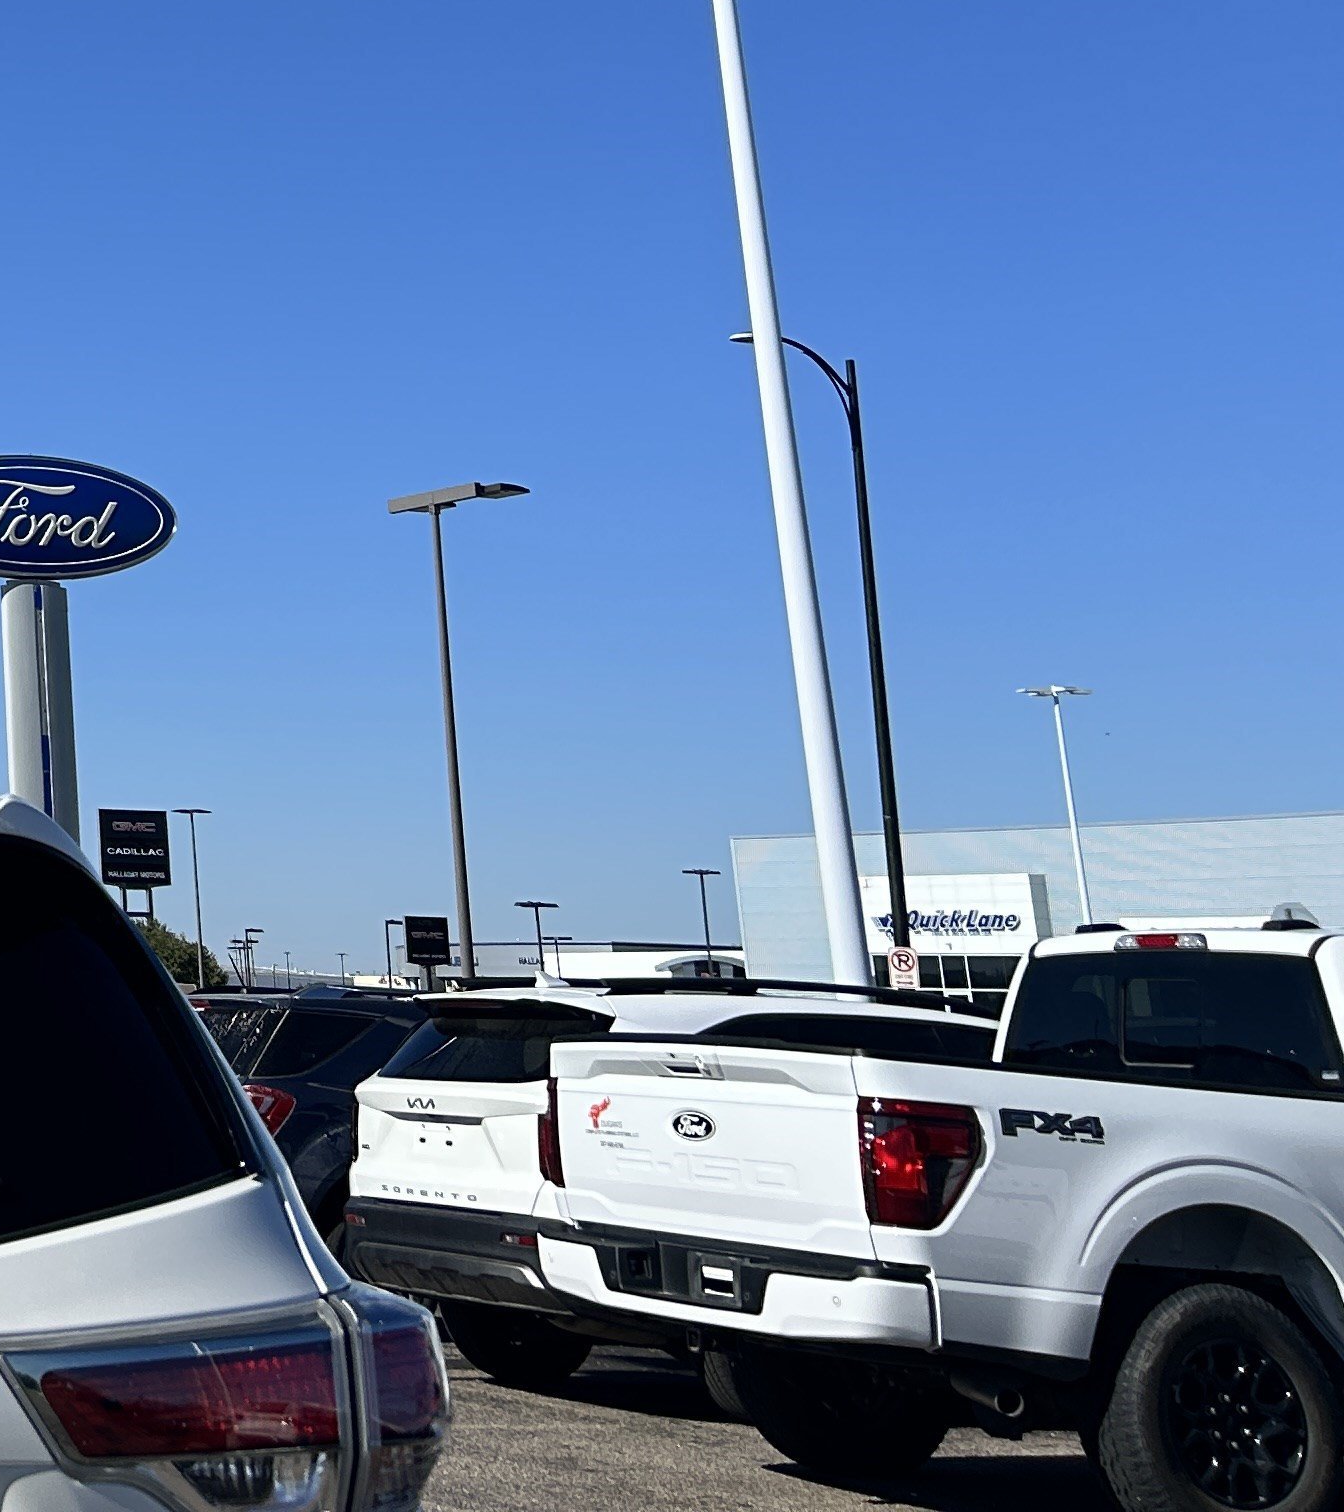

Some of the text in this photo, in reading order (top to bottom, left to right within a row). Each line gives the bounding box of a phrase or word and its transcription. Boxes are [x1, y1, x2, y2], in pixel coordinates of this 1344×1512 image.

[112, 821, 156, 832] GMC
[107, 848, 165, 856] CADILLAC
[908, 909, 1019, 930] Quick Lane
[677, 1114, 708, 1136] Ford
[999, 1108, 1104, 1139] FX4
[381, 1184, 477, 1202] SORENTO
